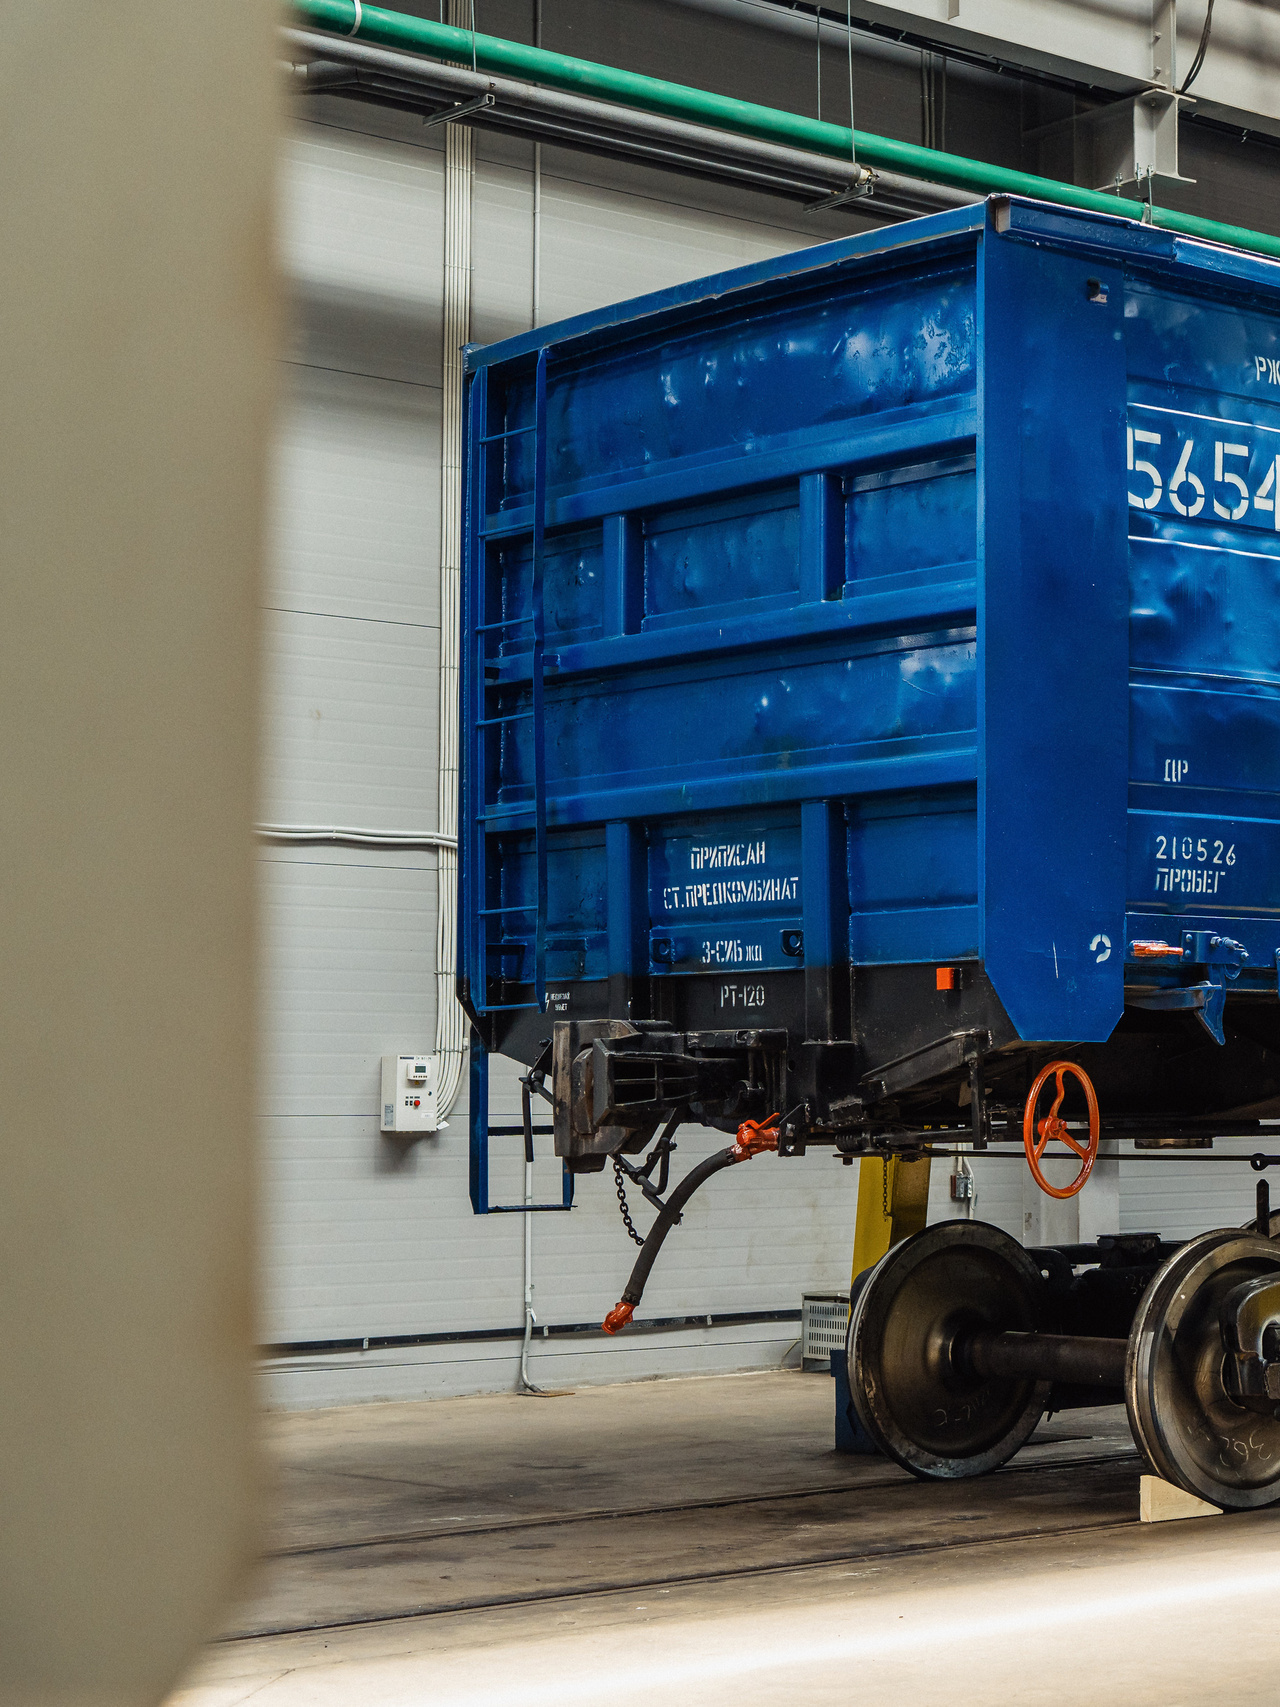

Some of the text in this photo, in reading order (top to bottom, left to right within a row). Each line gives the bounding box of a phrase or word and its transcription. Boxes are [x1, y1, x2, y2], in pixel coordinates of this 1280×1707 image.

[690, 841, 766, 870] ПРИПИСАН
[1156, 835, 1236, 866] 210526
[1155, 868, 1226, 893] ПРОБЕГ
[720, 984, 765, 1008] РТ-120
